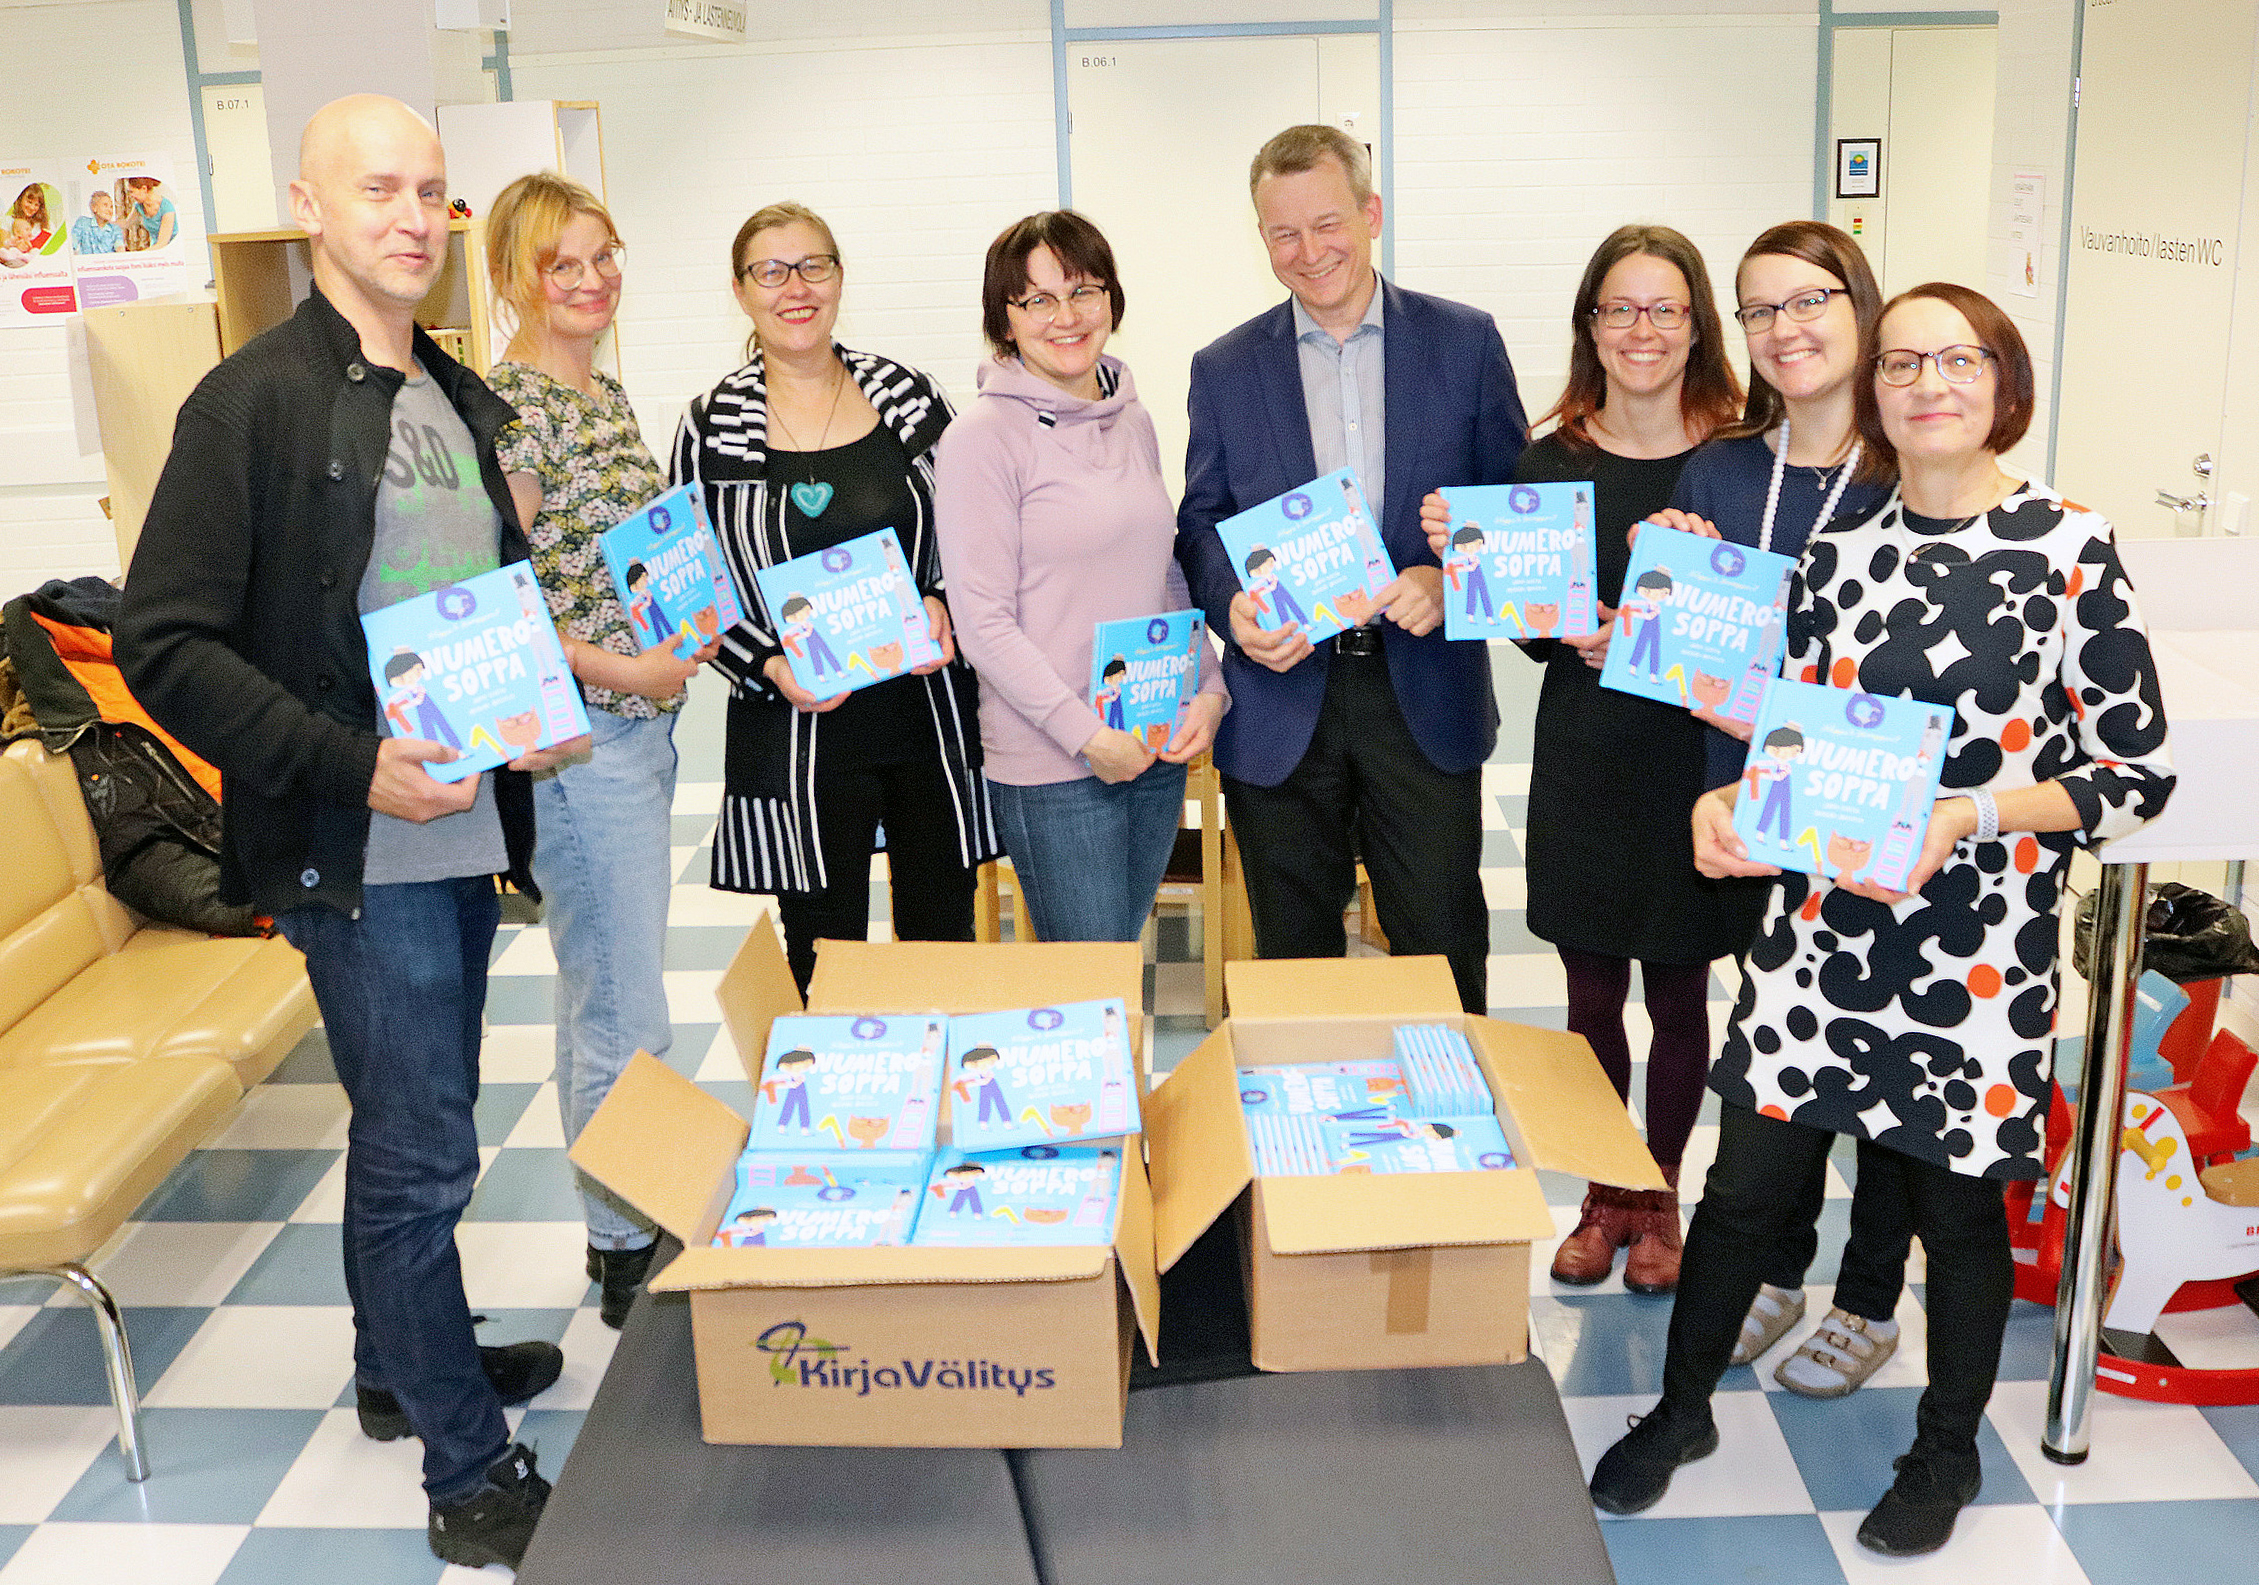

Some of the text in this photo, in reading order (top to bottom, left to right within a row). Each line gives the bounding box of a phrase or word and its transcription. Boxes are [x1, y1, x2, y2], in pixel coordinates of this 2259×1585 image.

[1081, 57, 1116, 68] B.06.1
[216, 99, 249, 110] B.07.1
[2197, 238, 2223, 266] WC
[644, 530, 706, 585] NUMERO
[1271, 515, 1358, 571] NUMERO
[1482, 528, 1577, 555] NUMERO
[659, 558, 707, 603] SOPPA
[1290, 542, 1356, 587] SOPPA
[1493, 554, 1562, 579] SOPPA
[809, 571, 896, 619] NUMERO
[1666, 581, 1774, 628] NUMERO
[826, 597, 893, 635] SOPPA
[1672, 612, 1750, 653] SOPPA
[419, 618, 532, 681] NUMERO
[442, 652, 527, 703] SOPPA
[1122, 654, 1190, 685] NUMERO
[1129, 677, 1177, 706] SOPPA
[1795, 737, 1919, 783] NUMERO
[1803, 769, 1891, 811] SOPPA
[809, 1051, 922, 1075] NUMERO
[995, 1036, 1108, 1071] NUMERO
[818, 1073, 901, 1095] SOPPA
[1011, 1059, 1093, 1089] SOPPA
[800, 1358, 1056, 1398] KirjaVälitys
